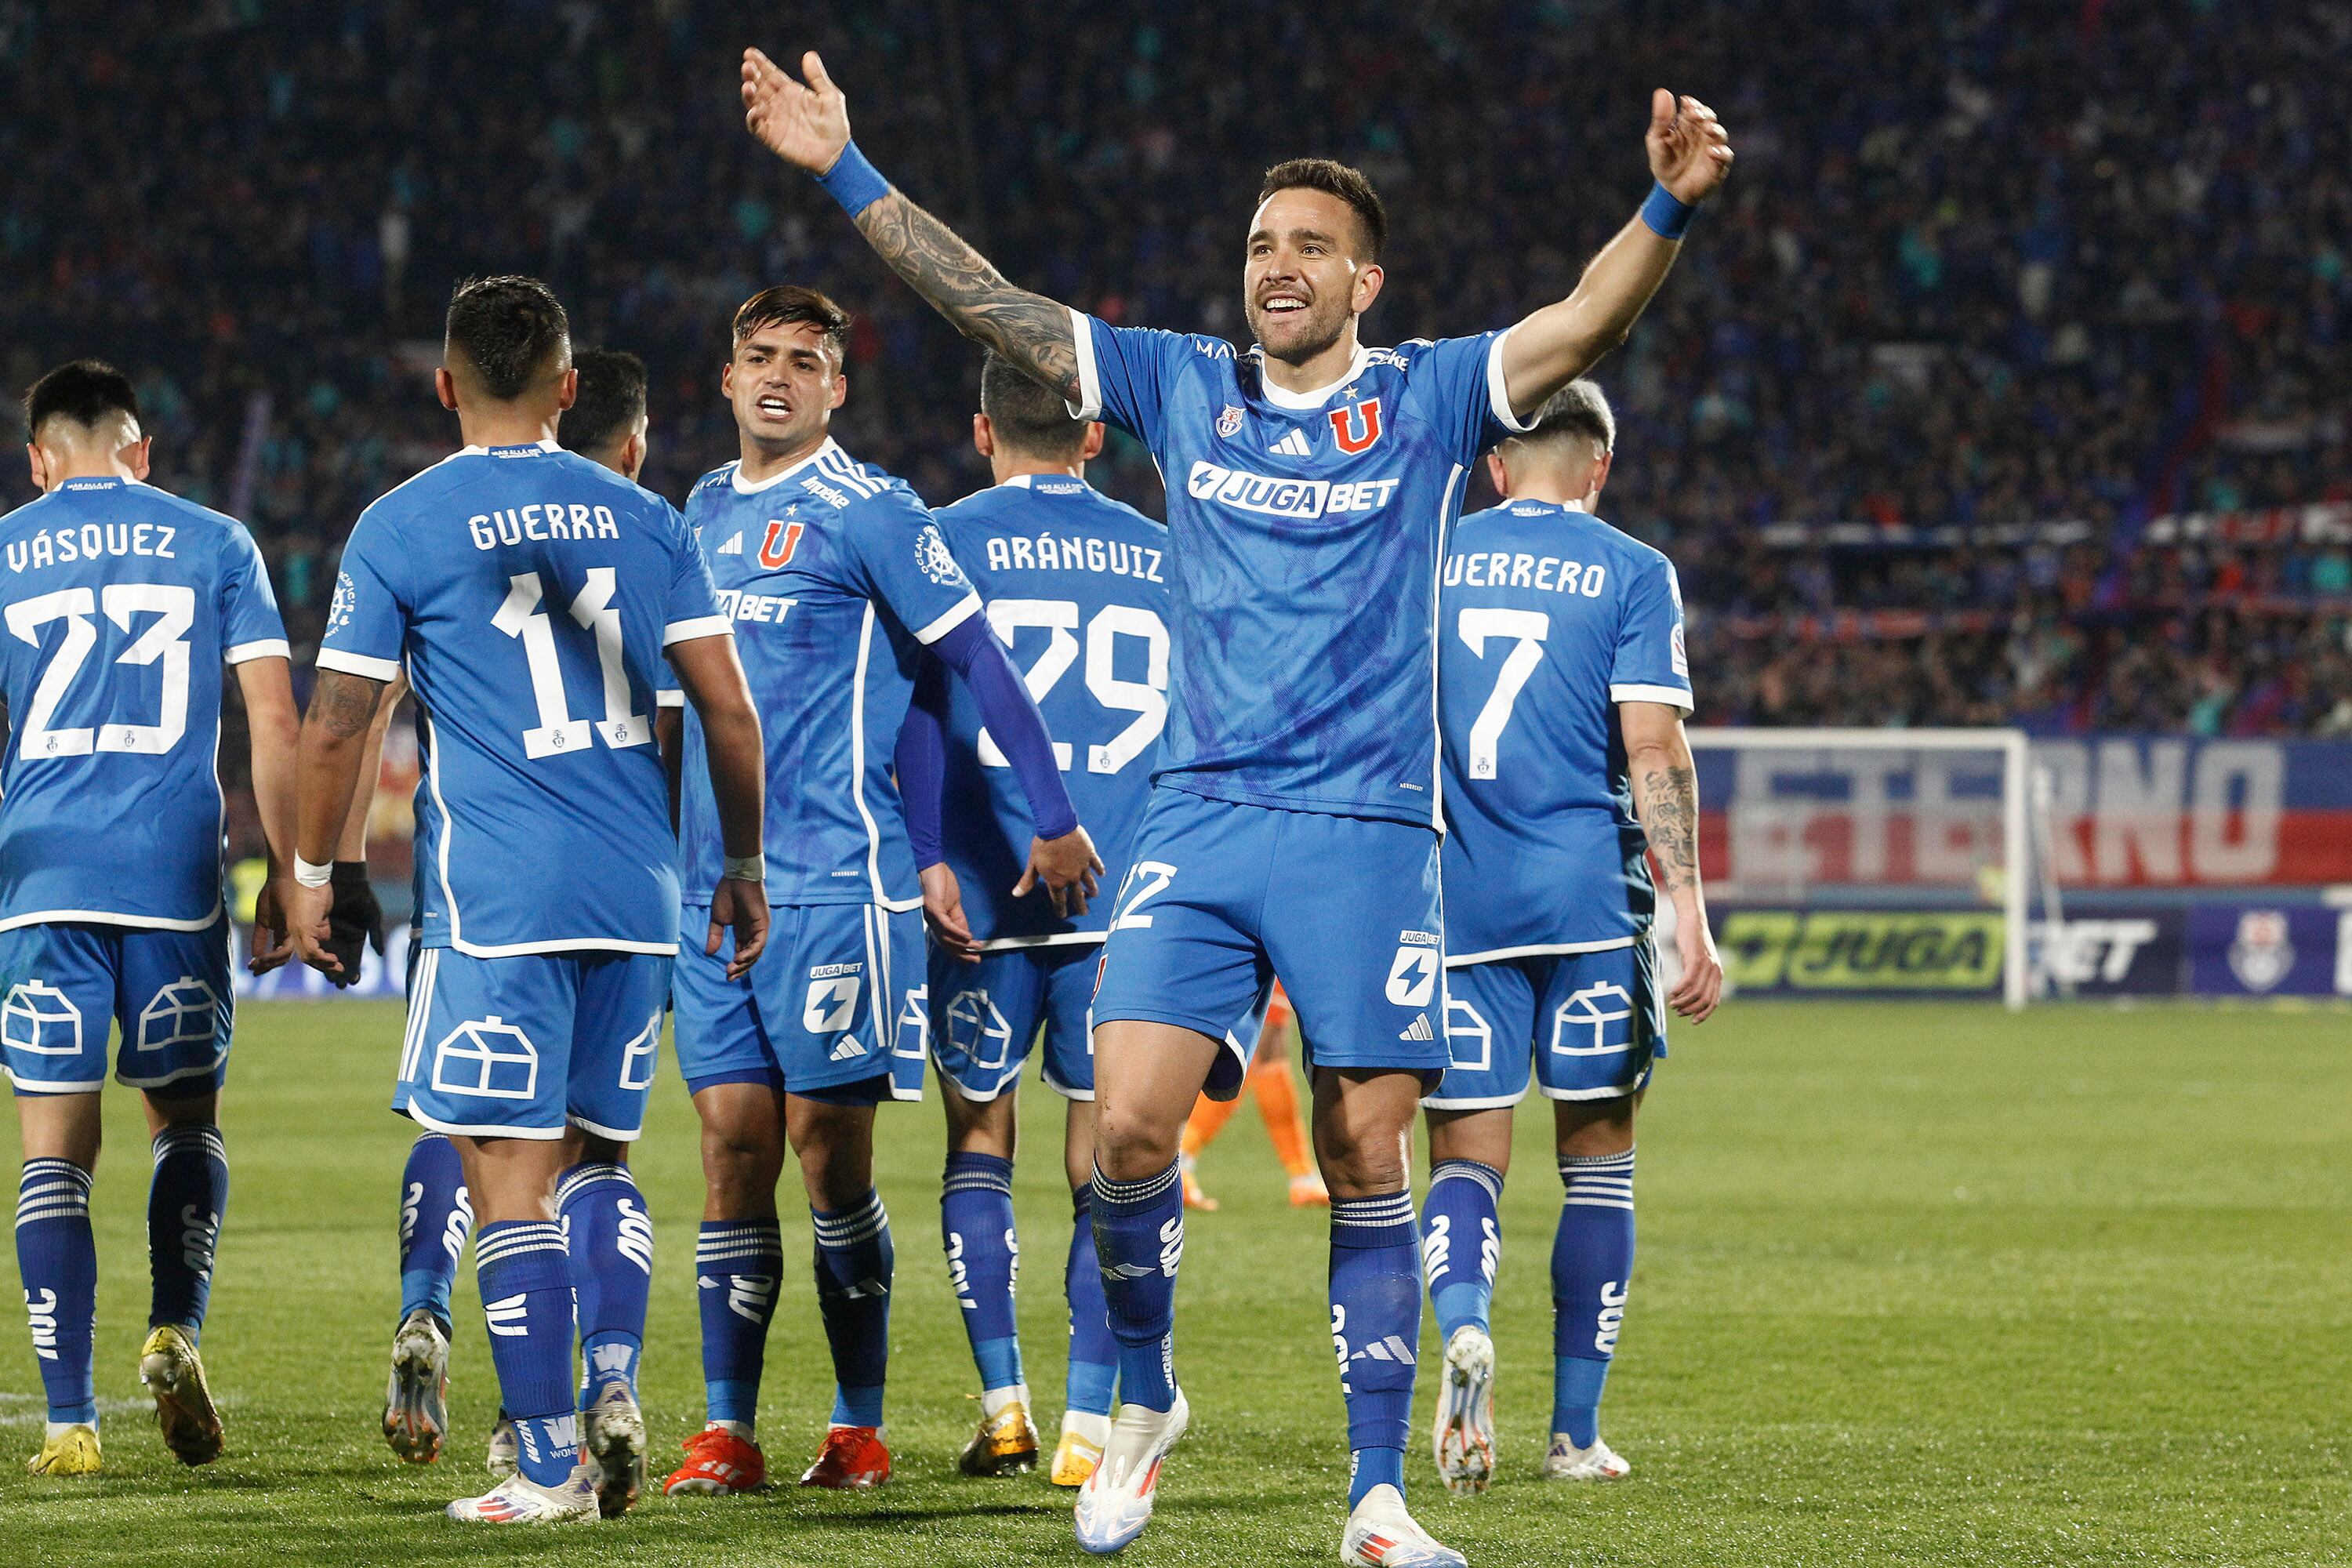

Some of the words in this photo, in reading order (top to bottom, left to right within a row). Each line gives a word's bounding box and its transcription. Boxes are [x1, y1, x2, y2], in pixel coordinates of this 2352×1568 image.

[1328, 397, 1383, 456] U
[800, 476, 851, 510] Impeke
[6, 524, 176, 574] VÁSQUEZ
[469, 503, 620, 551] GUERRA
[757, 519, 805, 571] U
[986, 532, 1164, 583] ARÁNGUIZ
[4, 583, 195, 760] 23
[490, 567, 652, 760] 11
[978, 599, 1171, 775] 29
[1457, 608, 1550, 779] 7
[1730, 739, 2287, 885] ETERNO
